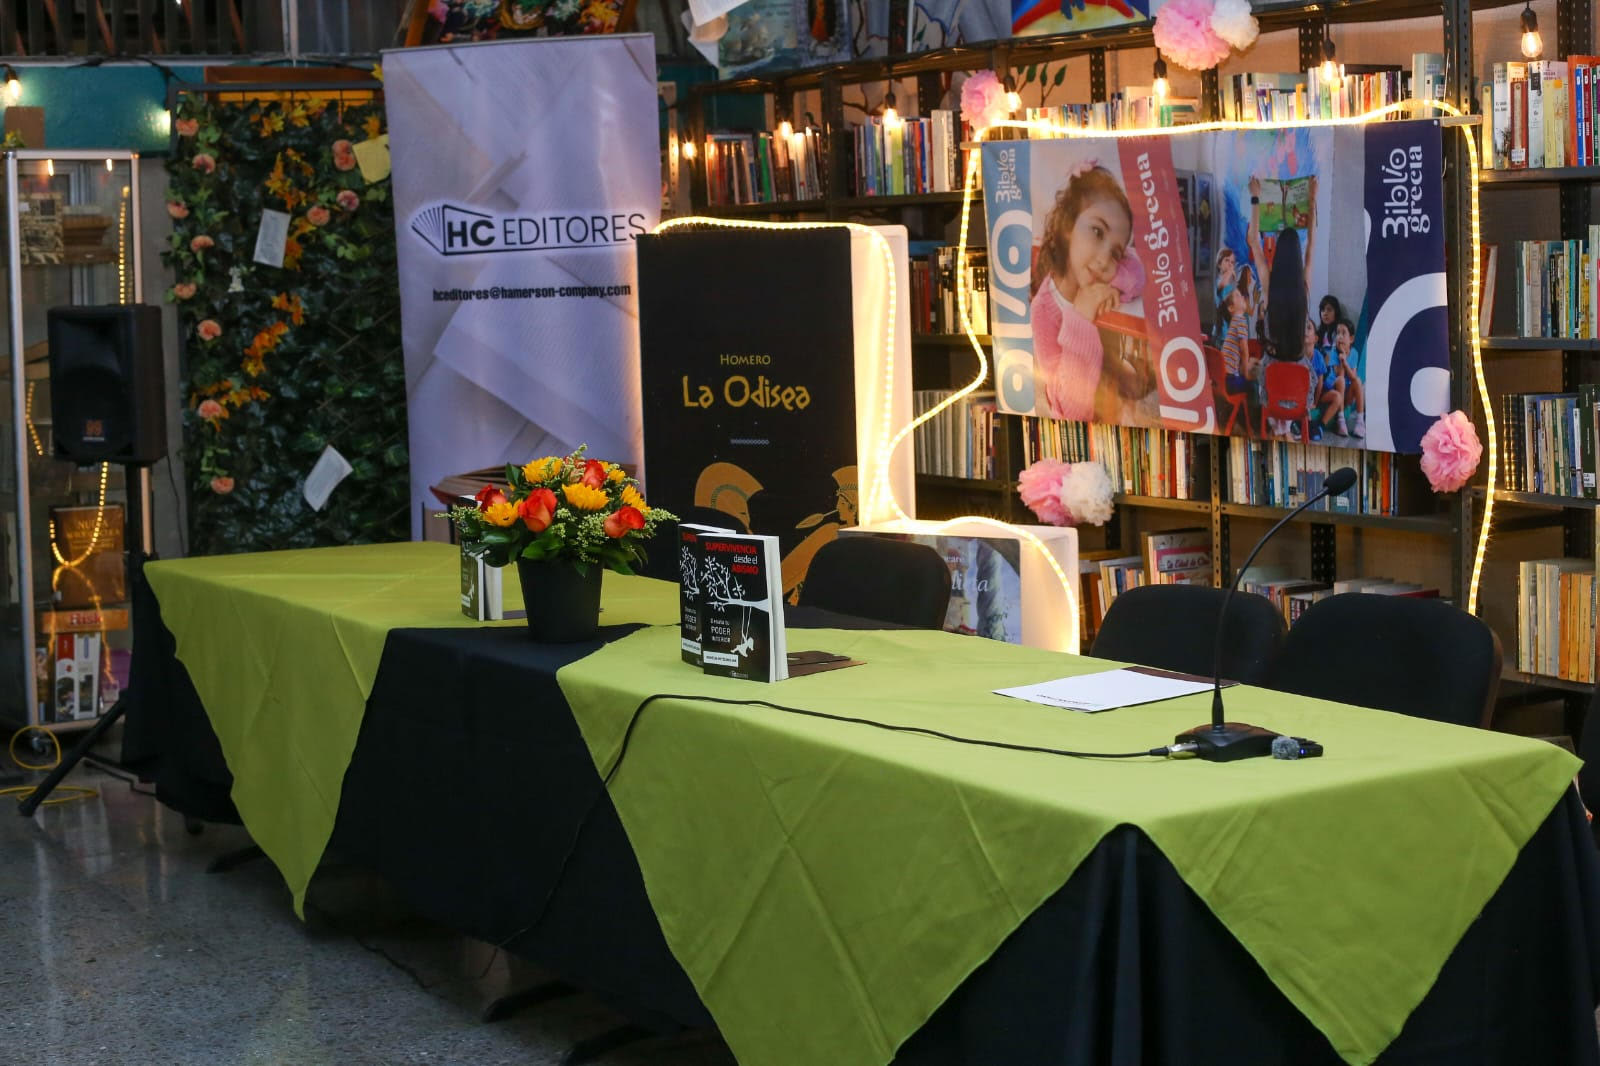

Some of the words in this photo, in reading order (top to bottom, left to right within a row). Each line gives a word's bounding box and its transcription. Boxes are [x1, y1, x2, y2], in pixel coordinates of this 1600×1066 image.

[1408, 145, 1431, 233] grecia
[1137, 152, 1169, 250] grecia
[447, 220, 496, 248] HC
[503, 213, 647, 246] EDITORES
[432, 284, 632, 302] hceditores@hamerson-company.com
[719, 354, 771, 366] HOMERO
[682, 375, 714, 409] La
[723, 375, 811, 411] Odisea
[704, 541, 758, 555] SUPERVIVENCIA
[733, 554, 752, 564] desde
[752, 556, 758, 565] el
[731, 563, 760, 576] ABISMO
